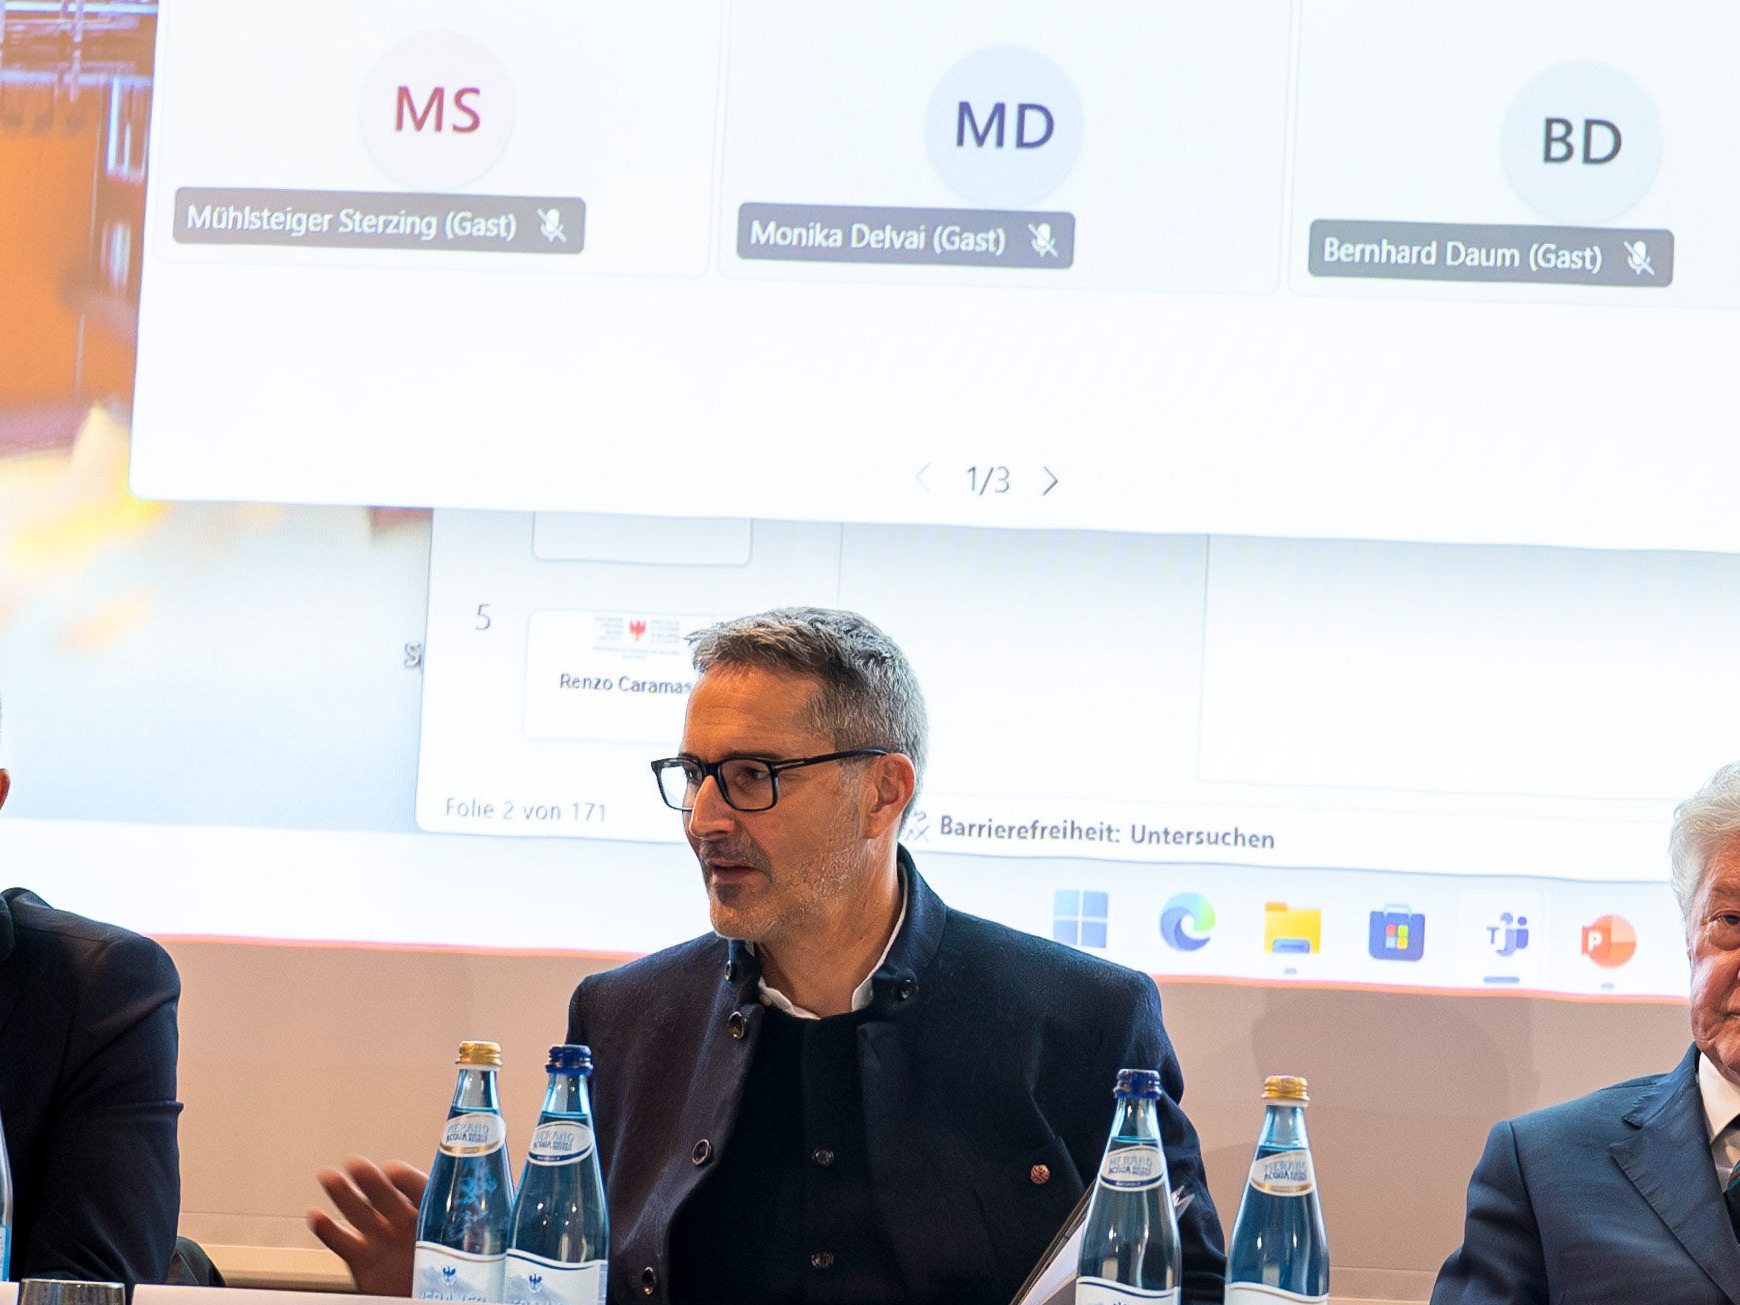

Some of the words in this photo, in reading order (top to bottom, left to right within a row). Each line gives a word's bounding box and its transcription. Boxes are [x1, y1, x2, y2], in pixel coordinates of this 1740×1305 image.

[395, 86, 481, 133] MS
[955, 101, 1055, 149] MD
[1543, 118, 1622, 165] BD
[187, 204, 332, 236] Mühlsteiger
[339, 209, 436, 240] Sterzing
[446, 212, 516, 241] (Gast)
[750, 221, 842, 247] Monika
[851, 224, 925, 250] Delvai
[933, 226, 1005, 255] (Gast)
[1323, 238, 1437, 266] Bernhard
[1445, 241, 1520, 267] Daum
[1529, 244, 1602, 273] (Gast)
[967, 466, 1010, 495] 1/3
[941, 815, 1121, 844] Barrierefreiheit:
[1131, 824, 1275, 849] Untersuchen
